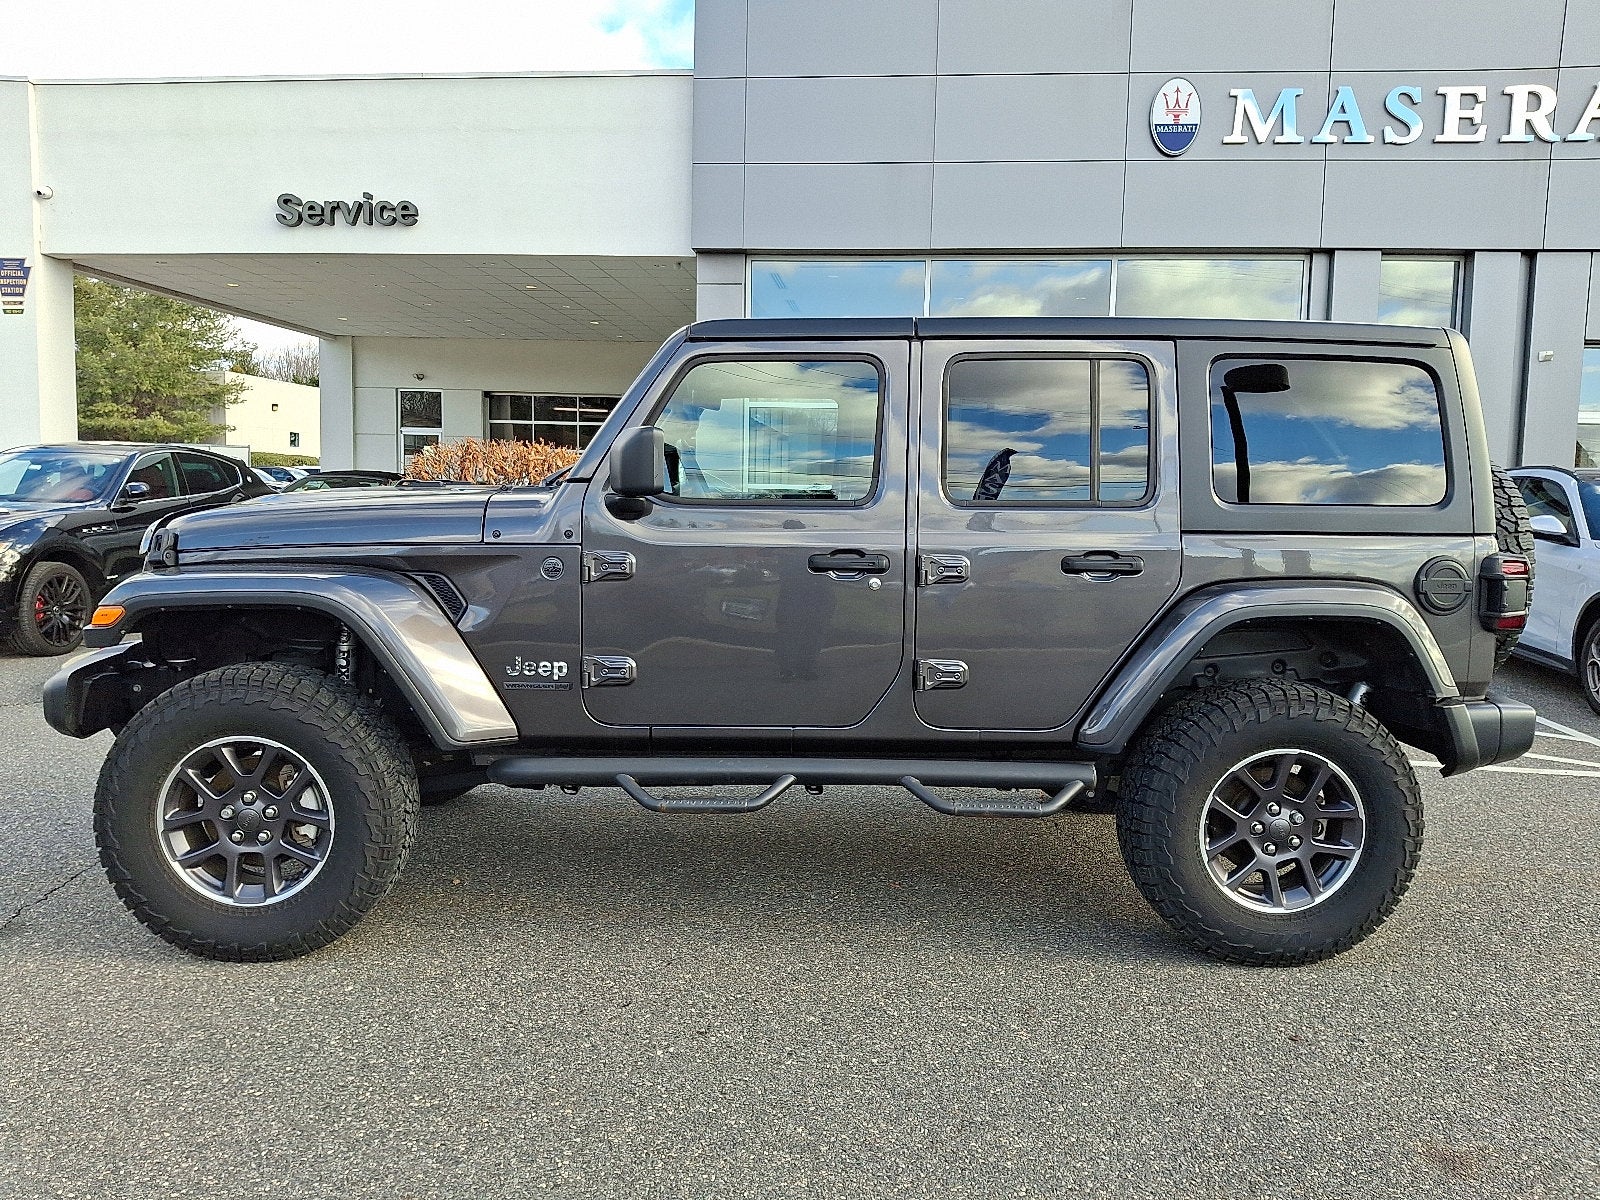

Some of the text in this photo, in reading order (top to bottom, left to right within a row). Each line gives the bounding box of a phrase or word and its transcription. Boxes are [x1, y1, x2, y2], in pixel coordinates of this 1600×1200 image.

[1156, 125, 1196, 133] MASERATI
[275, 192, 419, 227] Service
[505, 656, 568, 681] Jeep
